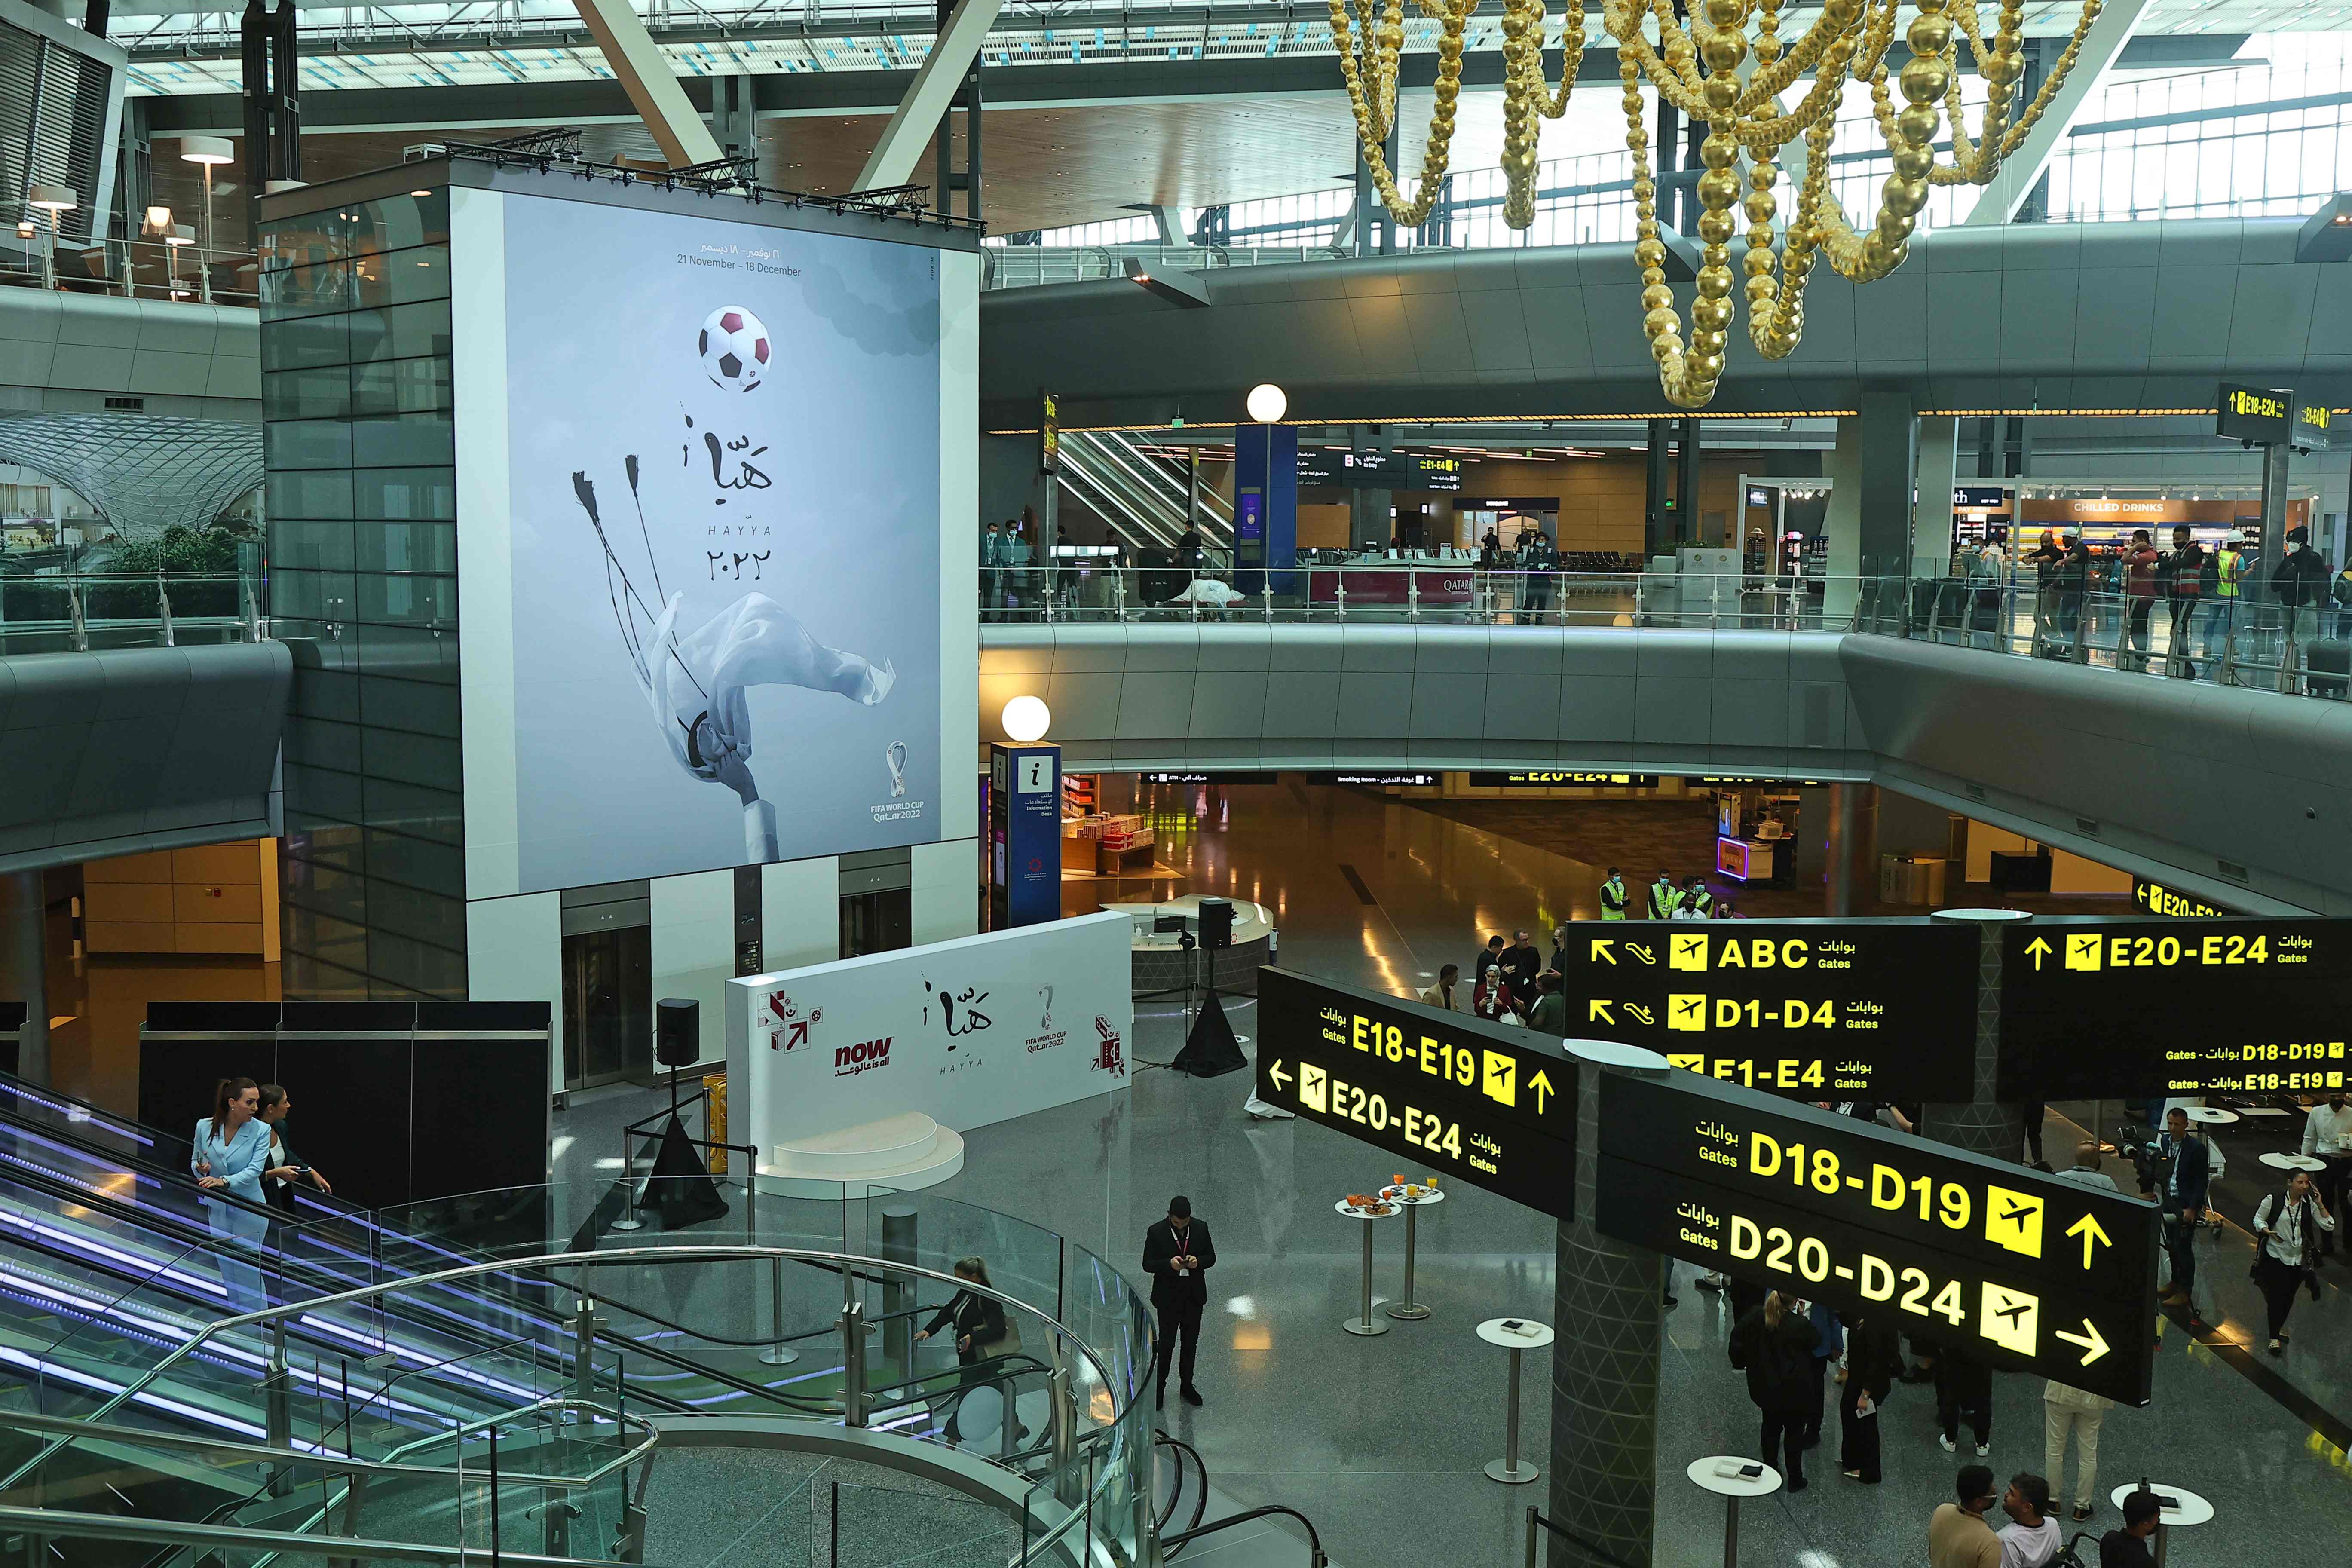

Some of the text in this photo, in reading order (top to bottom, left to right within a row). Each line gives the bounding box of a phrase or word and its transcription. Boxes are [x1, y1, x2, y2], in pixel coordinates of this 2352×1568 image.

[700, 244, 728, 254] ديسمبر
[747, 249, 771, 260] نوفمبر
[677, 254, 686, 264] 21
[689, 255, 735, 269] November
[745, 262, 755, 272] 18
[757, 263, 801, 277] December
[2246, 395, 2275, 417] E18-E24
[2306, 407, 2319, 425] E1-E4
[1427, 460, 1445, 470] E1-E4
[2074, 503, 2164, 512] CHILLED DRINKS
[708, 525, 771, 536] HAYYA
[707, 550, 771, 581] ٢٠٢٢
[1444, 579, 1469, 593] QATAR
[885, 802, 910, 811] WORLD
[1819, 940, 1855, 954] بوابات
[2110, 935, 2269, 967] E20-E24
[2278, 935, 2312, 949] بوابات
[1718, 939, 1808, 968] ABC
[2277, 954, 2308, 963] Gates
[1818, 959, 1850, 968] Gates
[1716, 999, 1836, 1028] D1-D4
[1846, 1001, 1883, 1014] بوابات
[1320, 1007, 1346, 1028] بوابات
[1846, 1019, 1878, 1029] Gates
[1025, 1037, 1037, 1046] FIFA
[1037, 1033, 1056, 1043] WORLD
[1323, 1028, 1346, 1044] Gates
[835, 1037, 892, 1068] now
[1353, 1014, 1475, 1086] E18-E19
[2166, 1050, 2196, 1060] Gates
[2205, 1047, 2239, 1061] بوابات
[2243, 1043, 2325, 1061] D18-D19
[872, 1060, 879, 1069] is
[879, 1056, 889, 1067] all
[940, 1058, 983, 1075] HAYYA
[1835, 1060, 1872, 1074] بوابات
[1714, 1059, 1825, 1088] E1-E4
[2168, 1080, 2199, 1090] Gates
[2208, 1077, 2242, 1090] بوابات
[2245, 1072, 2323, 1090] E18-E19
[1834, 1079, 1867, 1088] Gates
[1332, 1079, 1462, 1160] E20-E24
[1695, 1121, 1738, 1147] بوابات
[1469, 1133, 1501, 1158] بوابات
[1469, 1155, 1497, 1174] Gates
[1699, 1146, 1737, 1167] Gates
[1750, 1131, 1971, 1229] D18-D19
[1677, 1202, 1719, 1230] بوابات
[1680, 1228, 1718, 1250] Gates
[1730, 1215, 1965, 1326] D20-D24
